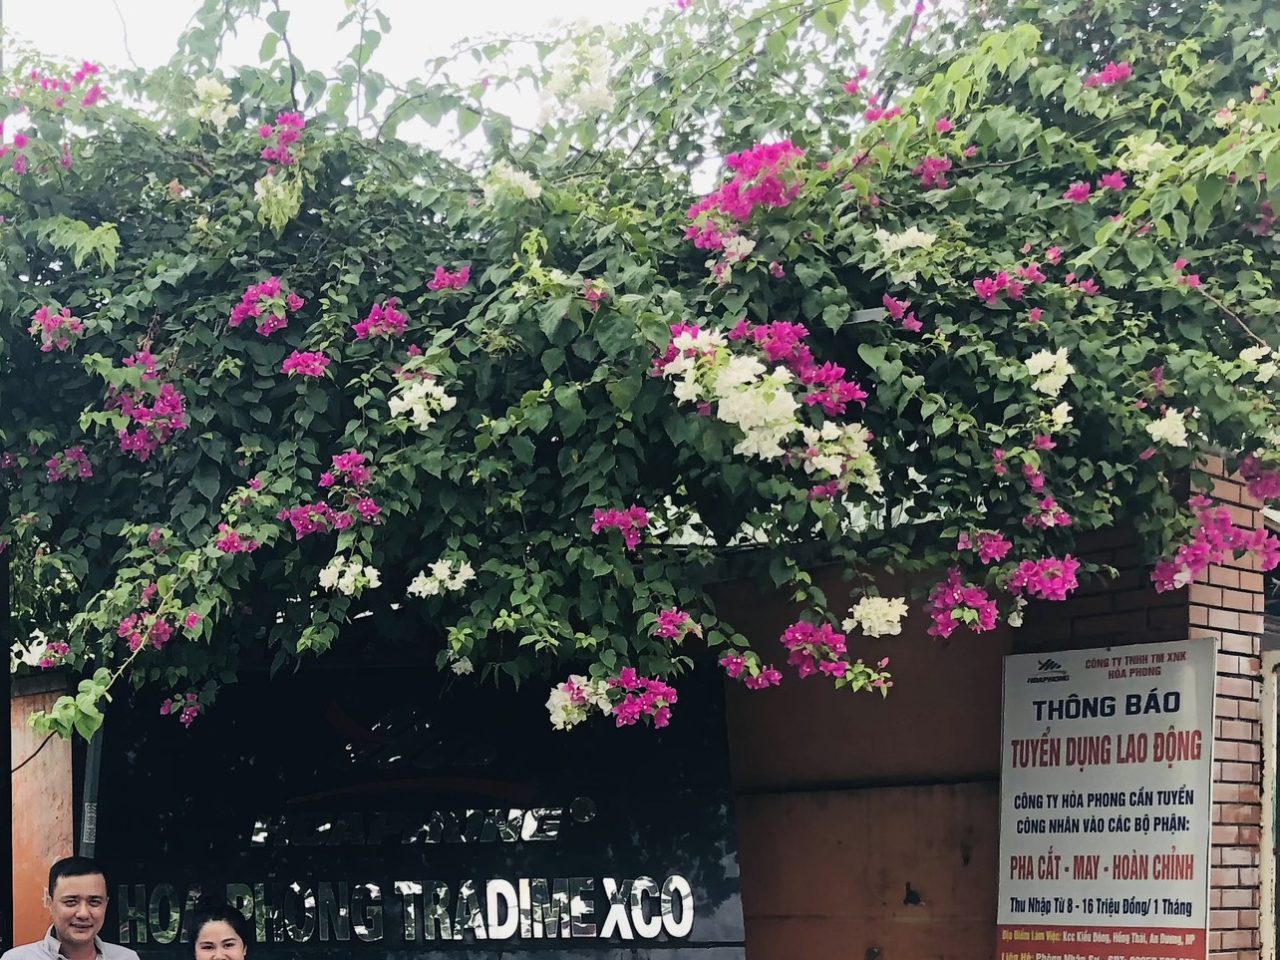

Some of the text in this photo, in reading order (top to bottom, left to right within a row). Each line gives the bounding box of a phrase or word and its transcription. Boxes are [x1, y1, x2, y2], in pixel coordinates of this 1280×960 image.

[1112, 656, 1122, 667] TY
[1151, 653, 1164, 664] TM
[1167, 651, 1187, 662] XNK
[1129, 666, 1162, 678] PHONG
[1032, 687, 1181, 721] THÔNG BÁO
[1011, 724, 1202, 772] TUYỂN DỤNG LAO ĐỘNG
[1014, 792, 1043, 809] CÔNG
[1046, 794, 1059, 808] TY
[1061, 790, 1084, 809] HÒA
[1087, 792, 1126, 808] PHONG
[1157, 784, 1194, 806] TUYỂN
[1016, 812, 1190, 836] CÔNG NHÂN VÀO CÁC BỘ PHẬN:
[1010, 855, 1034, 880] PHA
[1038, 845, 1061, 880] CẮT
[1073, 854, 1100, 880] MAY
[1113, 848, 1149, 880] HOÀN
[1152, 845, 1194, 880] CHỈNH
[225, 879, 384, 943] PHONG
[394, 873, 696, 942] TRADIMEXCO
[1010, 896, 1026, 913] Thu
[1028, 896, 1051, 917] Nhập
[1054, 896, 1065, 914] Từ
[1067, 897, 1073, 914] 8
[1082, 897, 1094, 914] 16
[1096, 897, 1120, 918] Triệu
[1153, 898, 1158, 915] 1
[1162, 898, 1192, 917] Tháng
